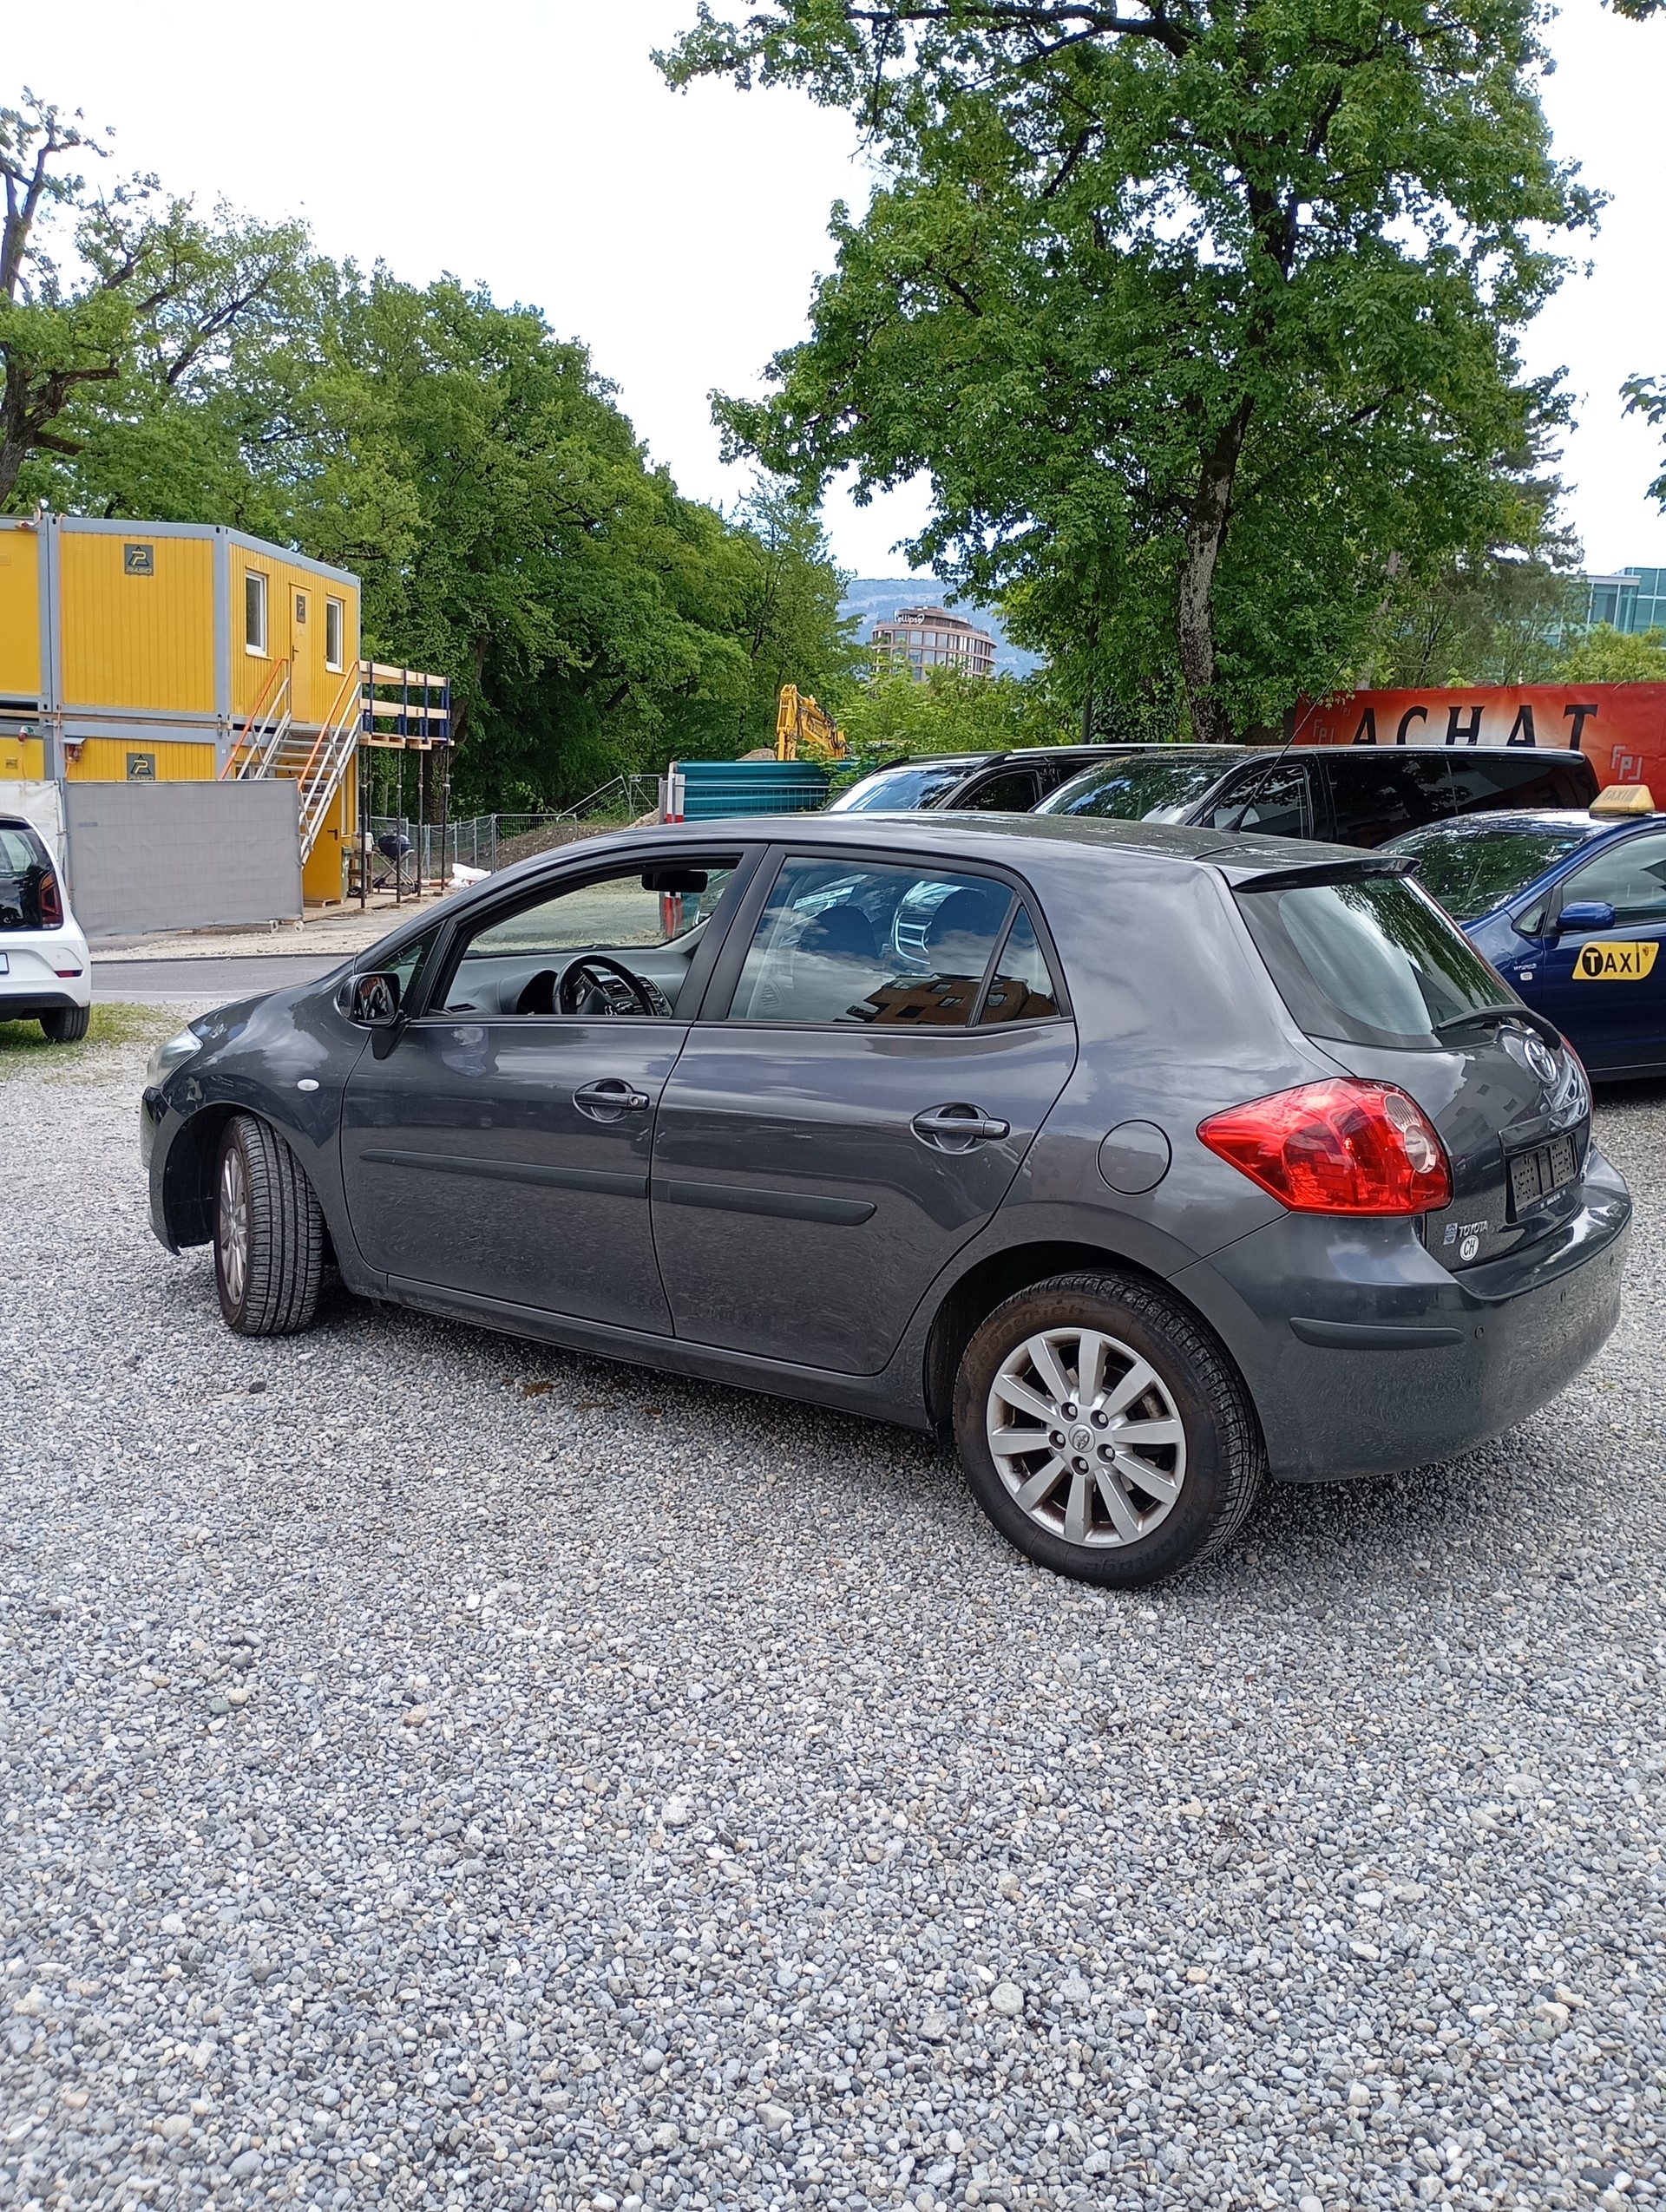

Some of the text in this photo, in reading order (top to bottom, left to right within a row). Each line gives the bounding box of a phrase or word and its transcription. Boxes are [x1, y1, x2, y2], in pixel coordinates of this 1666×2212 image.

[1352, 704, 1598, 750] ACHAT
[1603, 789, 1630, 802] TAXI
[1583, 948, 1641, 976] TAXI
[1459, 1220, 1488, 1238] TOYOTA
[1463, 1238, 1476, 1256] CH
